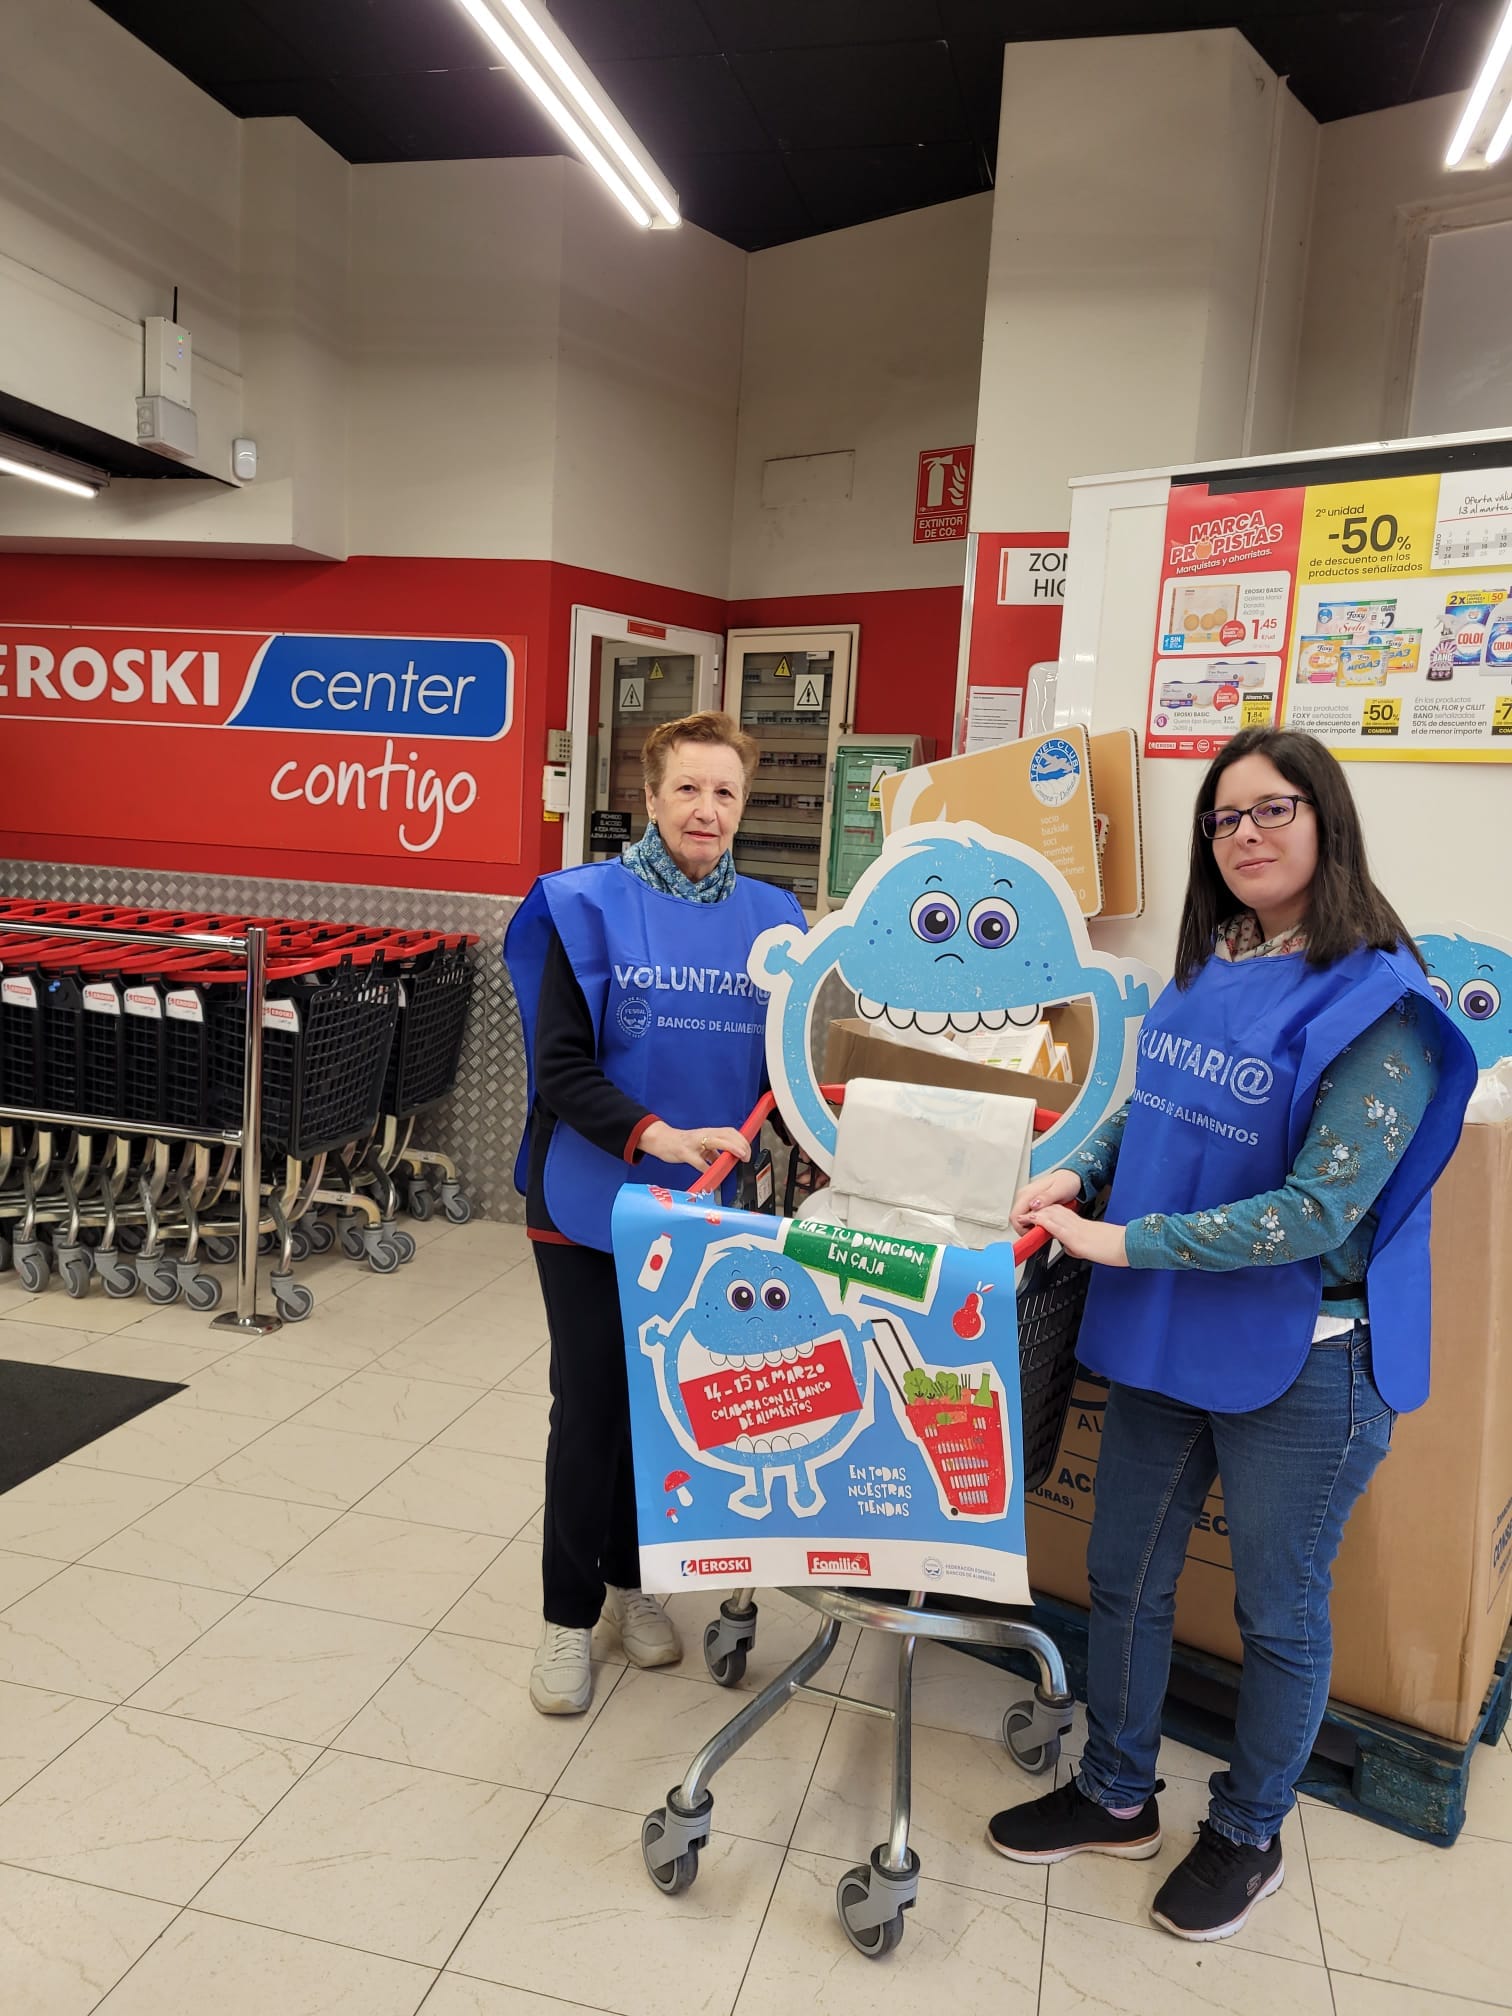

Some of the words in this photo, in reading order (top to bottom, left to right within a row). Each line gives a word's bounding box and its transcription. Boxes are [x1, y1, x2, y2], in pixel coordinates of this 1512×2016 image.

[1465, 494, 1492, 505] Oferta
[1328, 504, 1365, 516] unidad
[1470, 504, 1477, 514] al
[1480, 503, 1509, 513] martes
[920, 517, 963, 528] EXTINTOR
[1190, 509, 1266, 543] MARCA
[925, 529, 936, 538] DE
[1176, 559, 1221, 574] Marquistas
[1222, 558, 1227, 566] y
[1309, 558, 1322, 567] de
[1324, 554, 1378, 566] descuento
[1380, 553, 1393, 562] en
[1396, 552, 1411, 561] los
[1308, 567, 1360, 580] productos
[1362, 562, 1423, 575] señalizados
[1346, 611, 1366, 620] Foxy
[0, 644, 219, 706] ROSKI
[291, 661, 476, 715] center
[1414, 704, 1440, 712] COLON,
[1435, 696, 1471, 704] productos
[1330, 727, 1356, 735] importe
[1453, 728, 1482, 736] importe
[1031, 741, 1055, 780] TRAVEL
[1057, 741, 1079, 769] CLUB
[271, 739, 477, 852] contigo
[657, 1016, 706, 1030] BANCOS
[709, 1021, 721, 1031] DE
[1174, 1106, 1259, 1146] ALIMENTOS
[798, 1220, 827, 1235] HAZ
[831, 1227, 850, 1240] TU
[851, 1232, 925, 1265] DONACIÓN
[828, 1243, 848, 1265] EN
[850, 1252, 887, 1275] CAJA
[755, 1376, 770, 1391] DE
[771, 1363, 825, 1385] MARZO
[711, 1399, 761, 1420] COLABORA
[761, 1394, 783, 1407] CON
[783, 1388, 795, 1402] EL
[796, 1381, 832, 1400] BANCO
[738, 1413, 754, 1431] DE
[756, 1400, 813, 1425] ALIMENTOS
[848, 1464, 867, 1480] EN
[868, 1466, 906, 1482] TODAS
[848, 1482, 912, 1499] NUESTRAS
[1029, 1487, 1074, 1510] URAS)
[857, 1500, 910, 1517] TIENDAS
[701, 1559, 750, 1573] EROSKI
